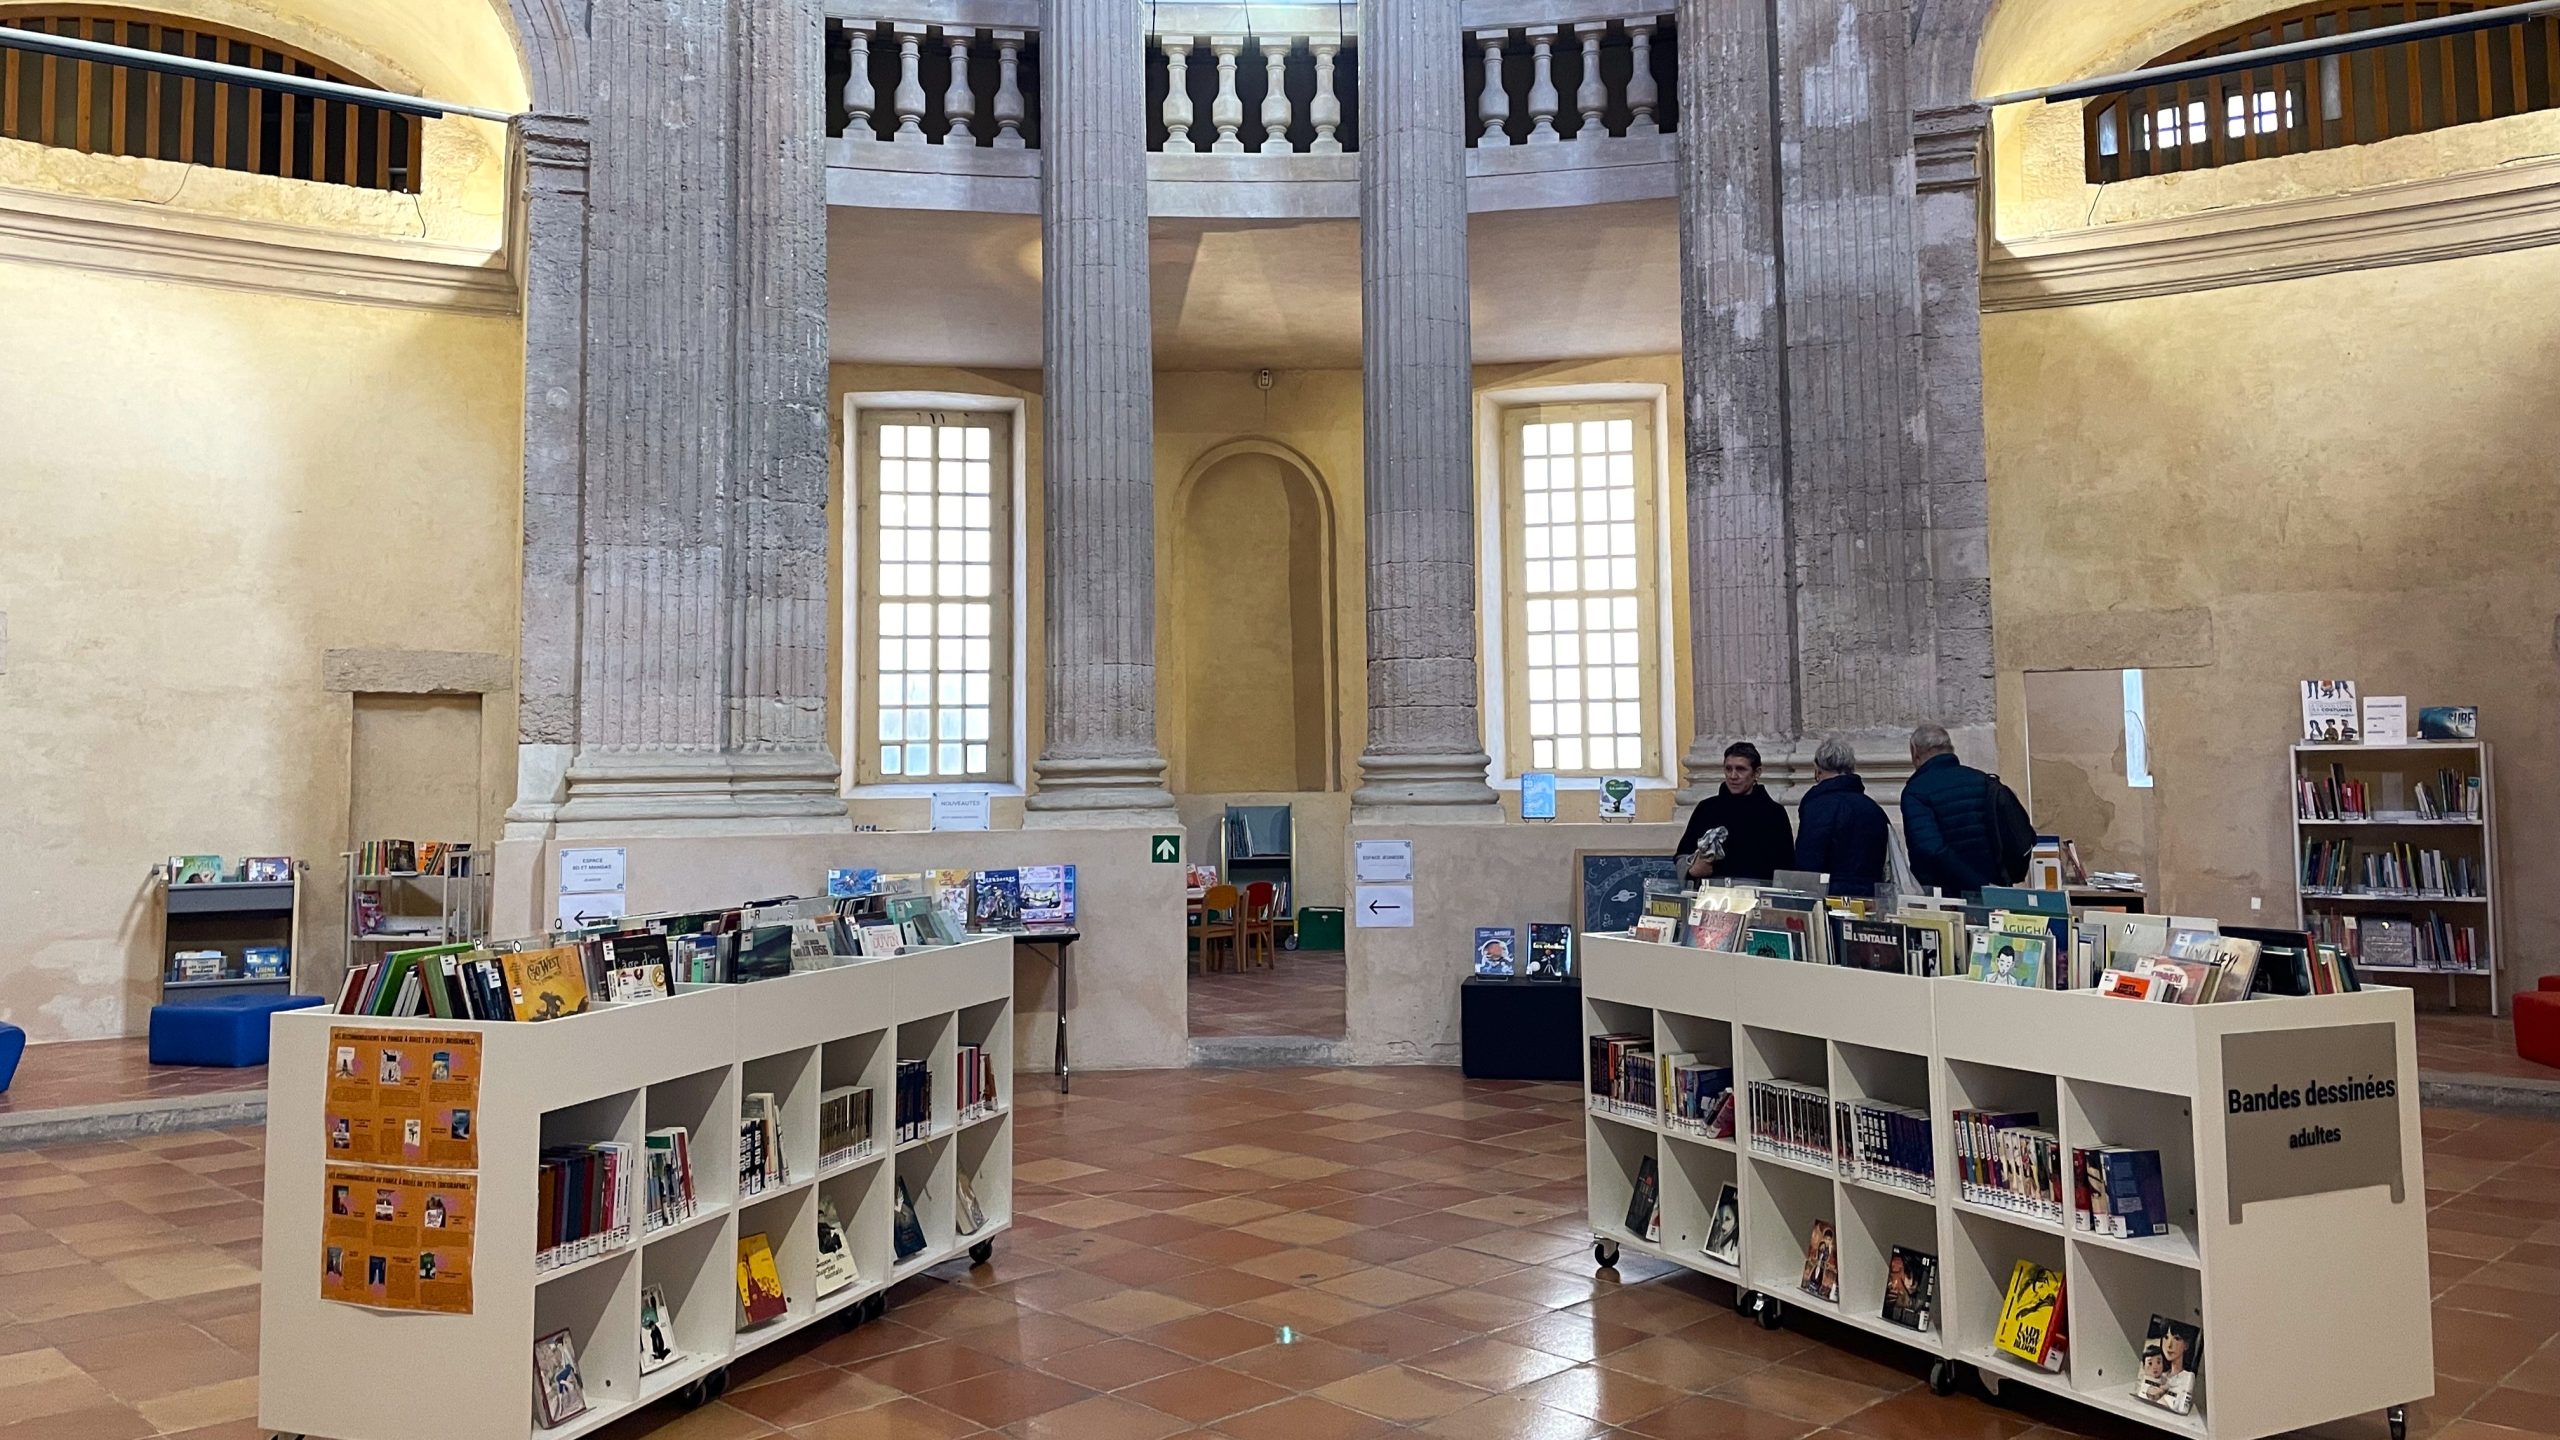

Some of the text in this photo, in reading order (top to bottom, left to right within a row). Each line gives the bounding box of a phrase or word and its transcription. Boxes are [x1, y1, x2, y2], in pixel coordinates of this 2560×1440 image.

[2448, 711, 2474, 726] SURF
[1842, 896, 1851, 907] M
[754, 909, 761, 920] R
[554, 918, 563, 930] Q
[2124, 923, 2135, 936] N
[1853, 932, 1898, 946] L'ENTAILLE
[513, 940, 522, 953] O
[811, 945, 829, 956] 1956
[2228, 1074, 2396, 1114] Bandes dessinées
[2289, 1125, 2342, 1149] adultes
[1922, 1257, 1930, 1267] 01
[2017, 1322, 2041, 1340] LADY
[2013, 1338, 2038, 1355] BLOOD
